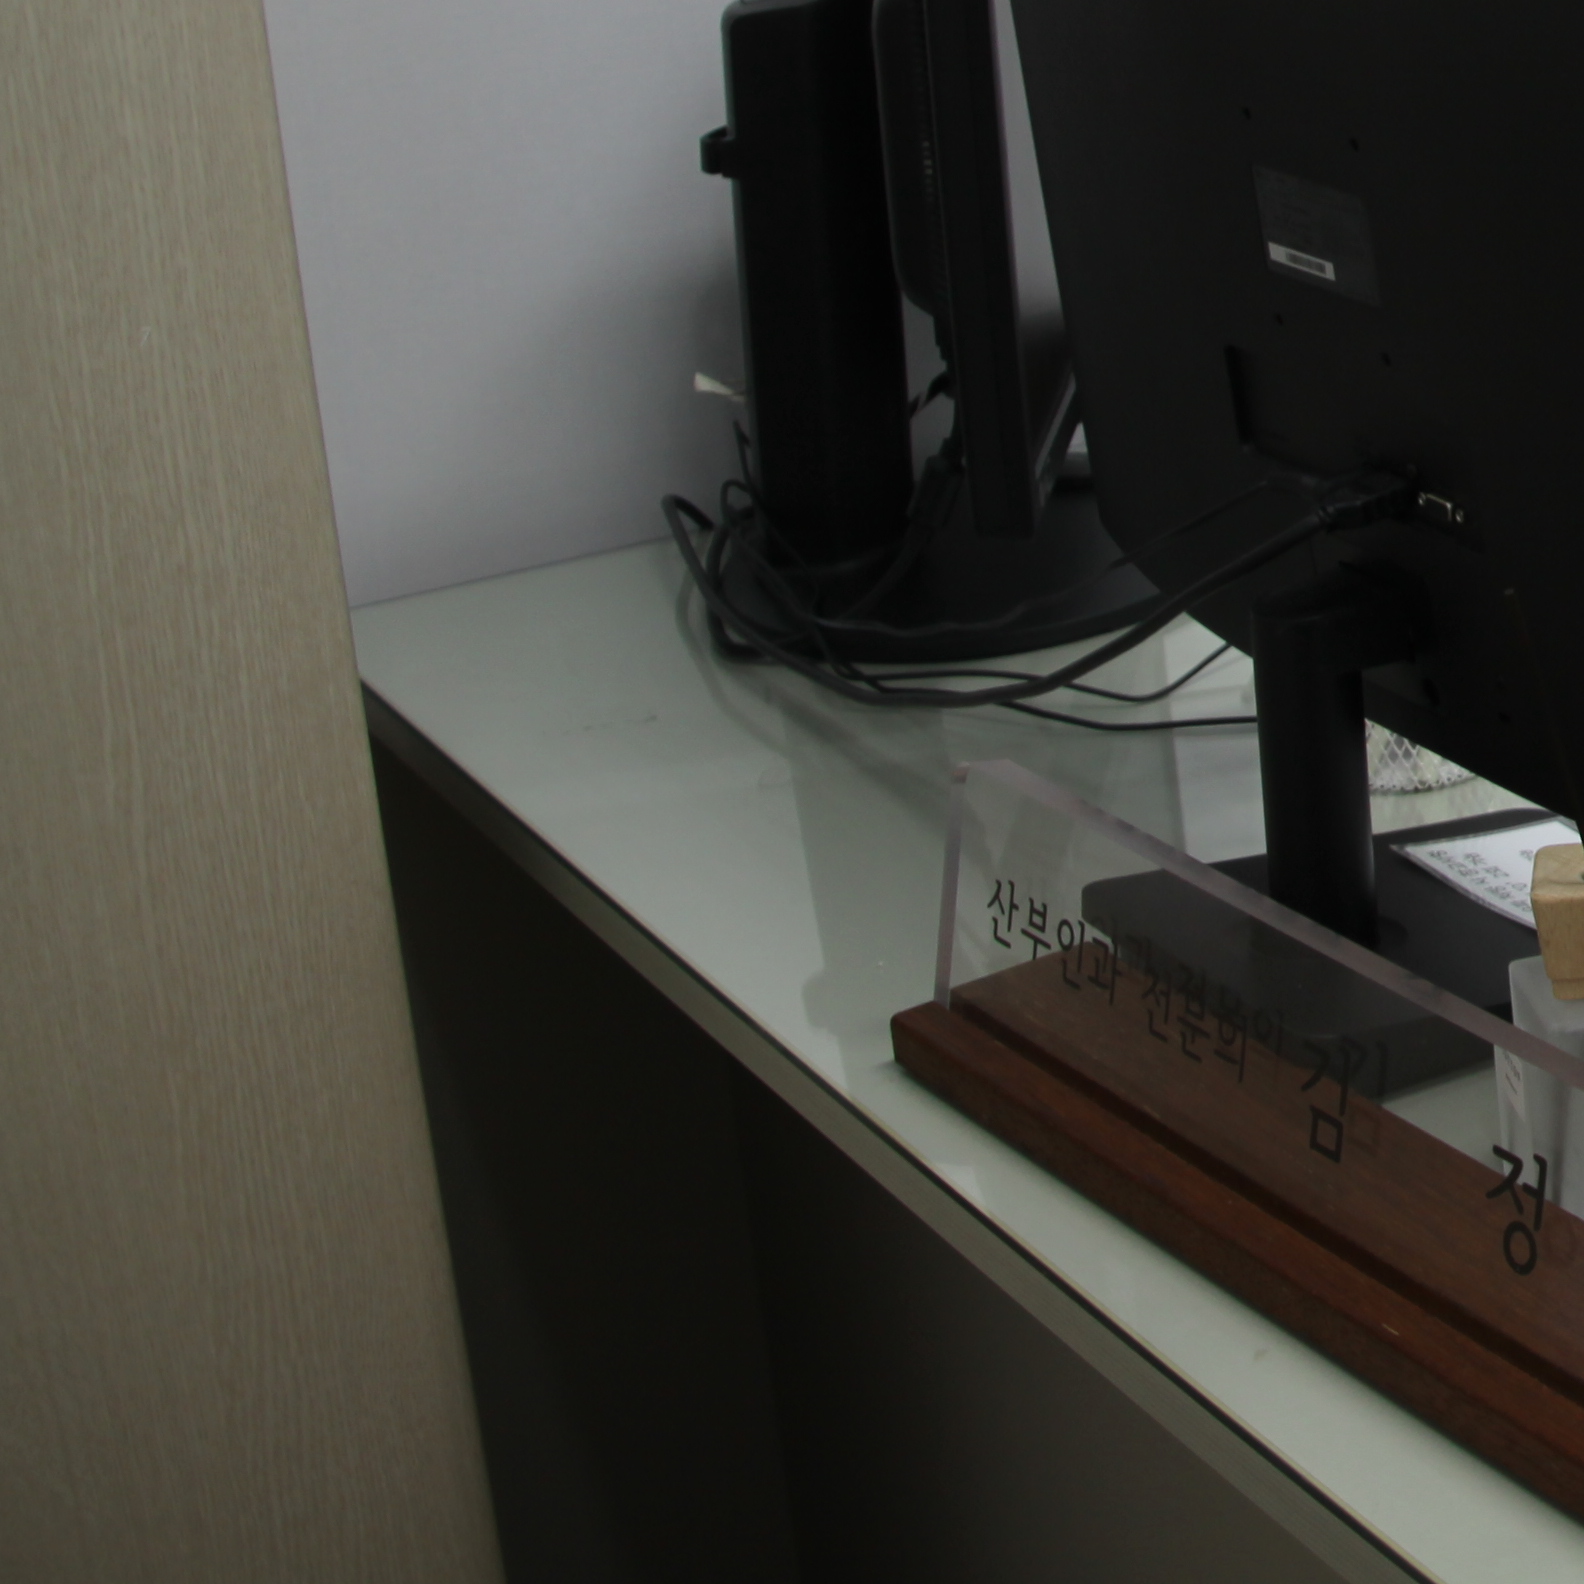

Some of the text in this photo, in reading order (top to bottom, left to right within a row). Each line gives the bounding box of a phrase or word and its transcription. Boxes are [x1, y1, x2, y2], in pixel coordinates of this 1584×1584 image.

[987, 878, 1122, 1006] 산부인과
[1141, 966, 1248, 1083] 전문의
[1302, 1038, 1352, 1164] 김
[1486, 1145, 1548, 1276] 정
